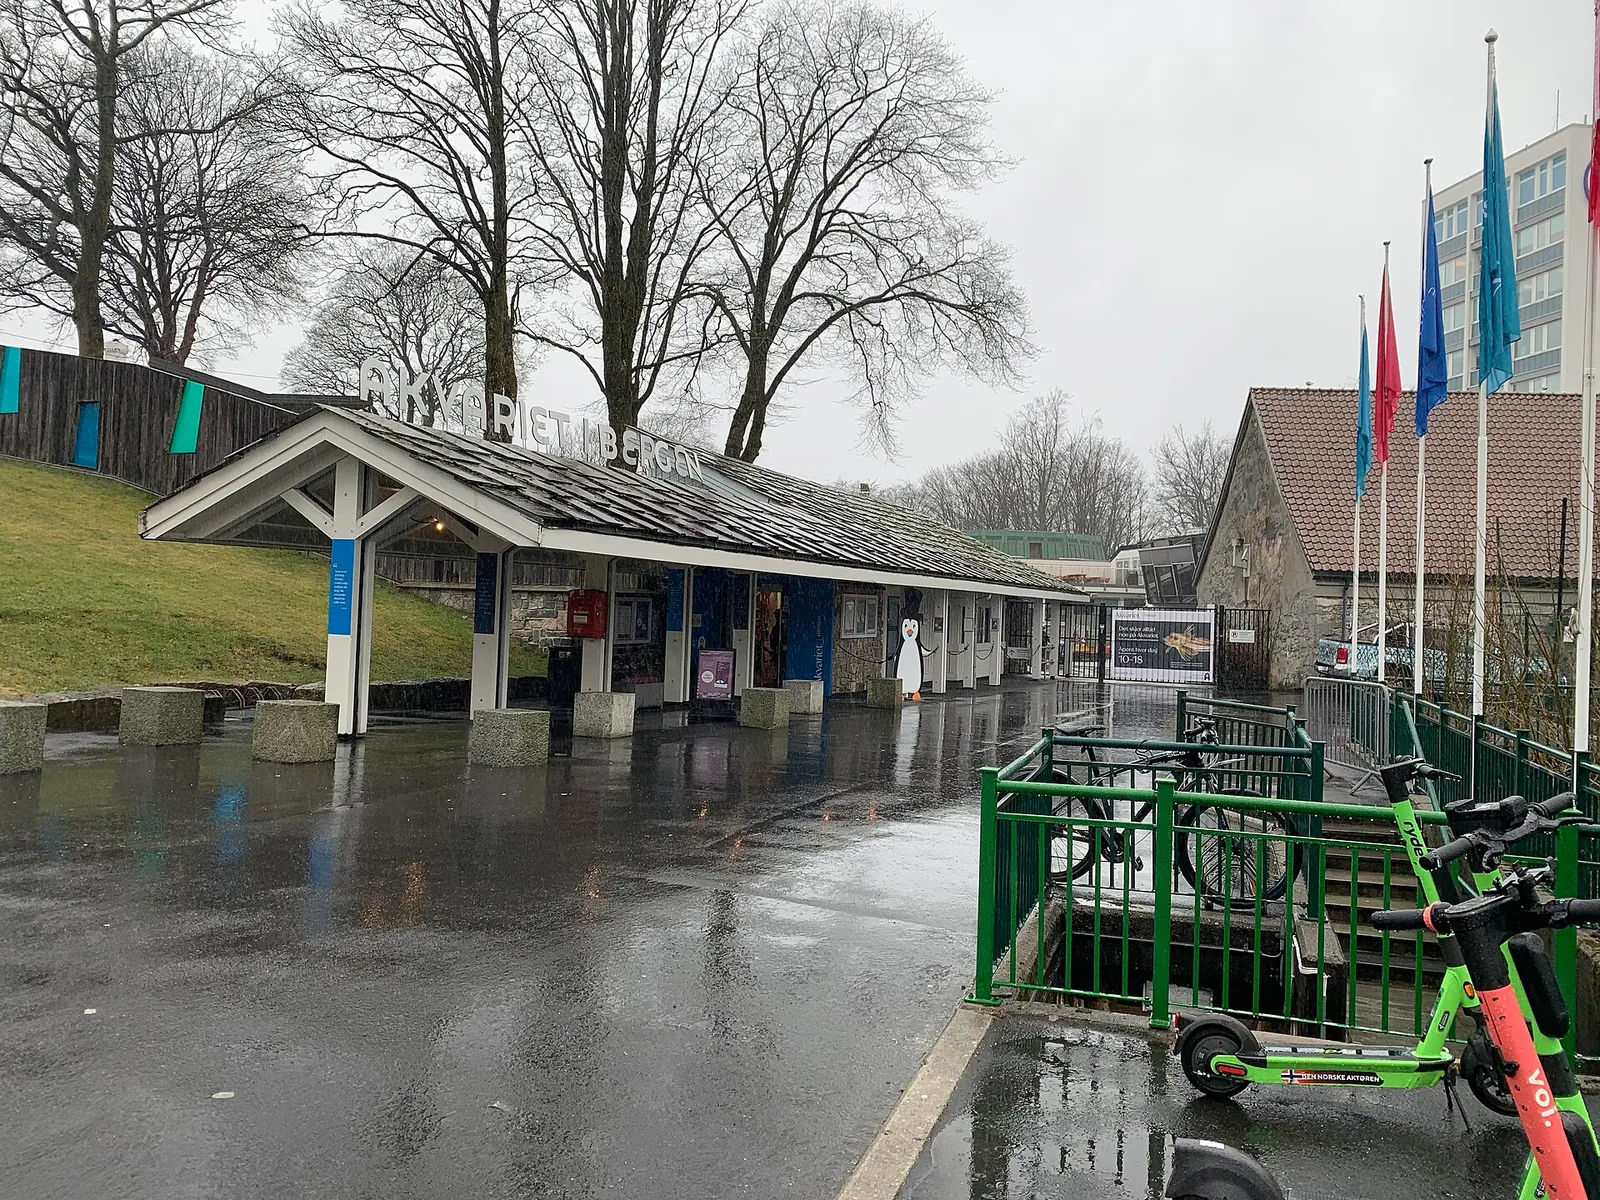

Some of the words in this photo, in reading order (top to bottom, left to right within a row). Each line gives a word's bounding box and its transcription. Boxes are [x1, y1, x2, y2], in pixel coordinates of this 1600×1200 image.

[359, 357, 571, 449] AKVARIET
[582, 417, 590, 455] I
[597, 423, 704, 483] BERGEN
[813, 644, 824, 681] kvariet
[1118, 655, 1144, 664] 10-18
[1402, 821, 1424, 857] ryde
[1346, 1075, 1380, 1083] AKTØREN
